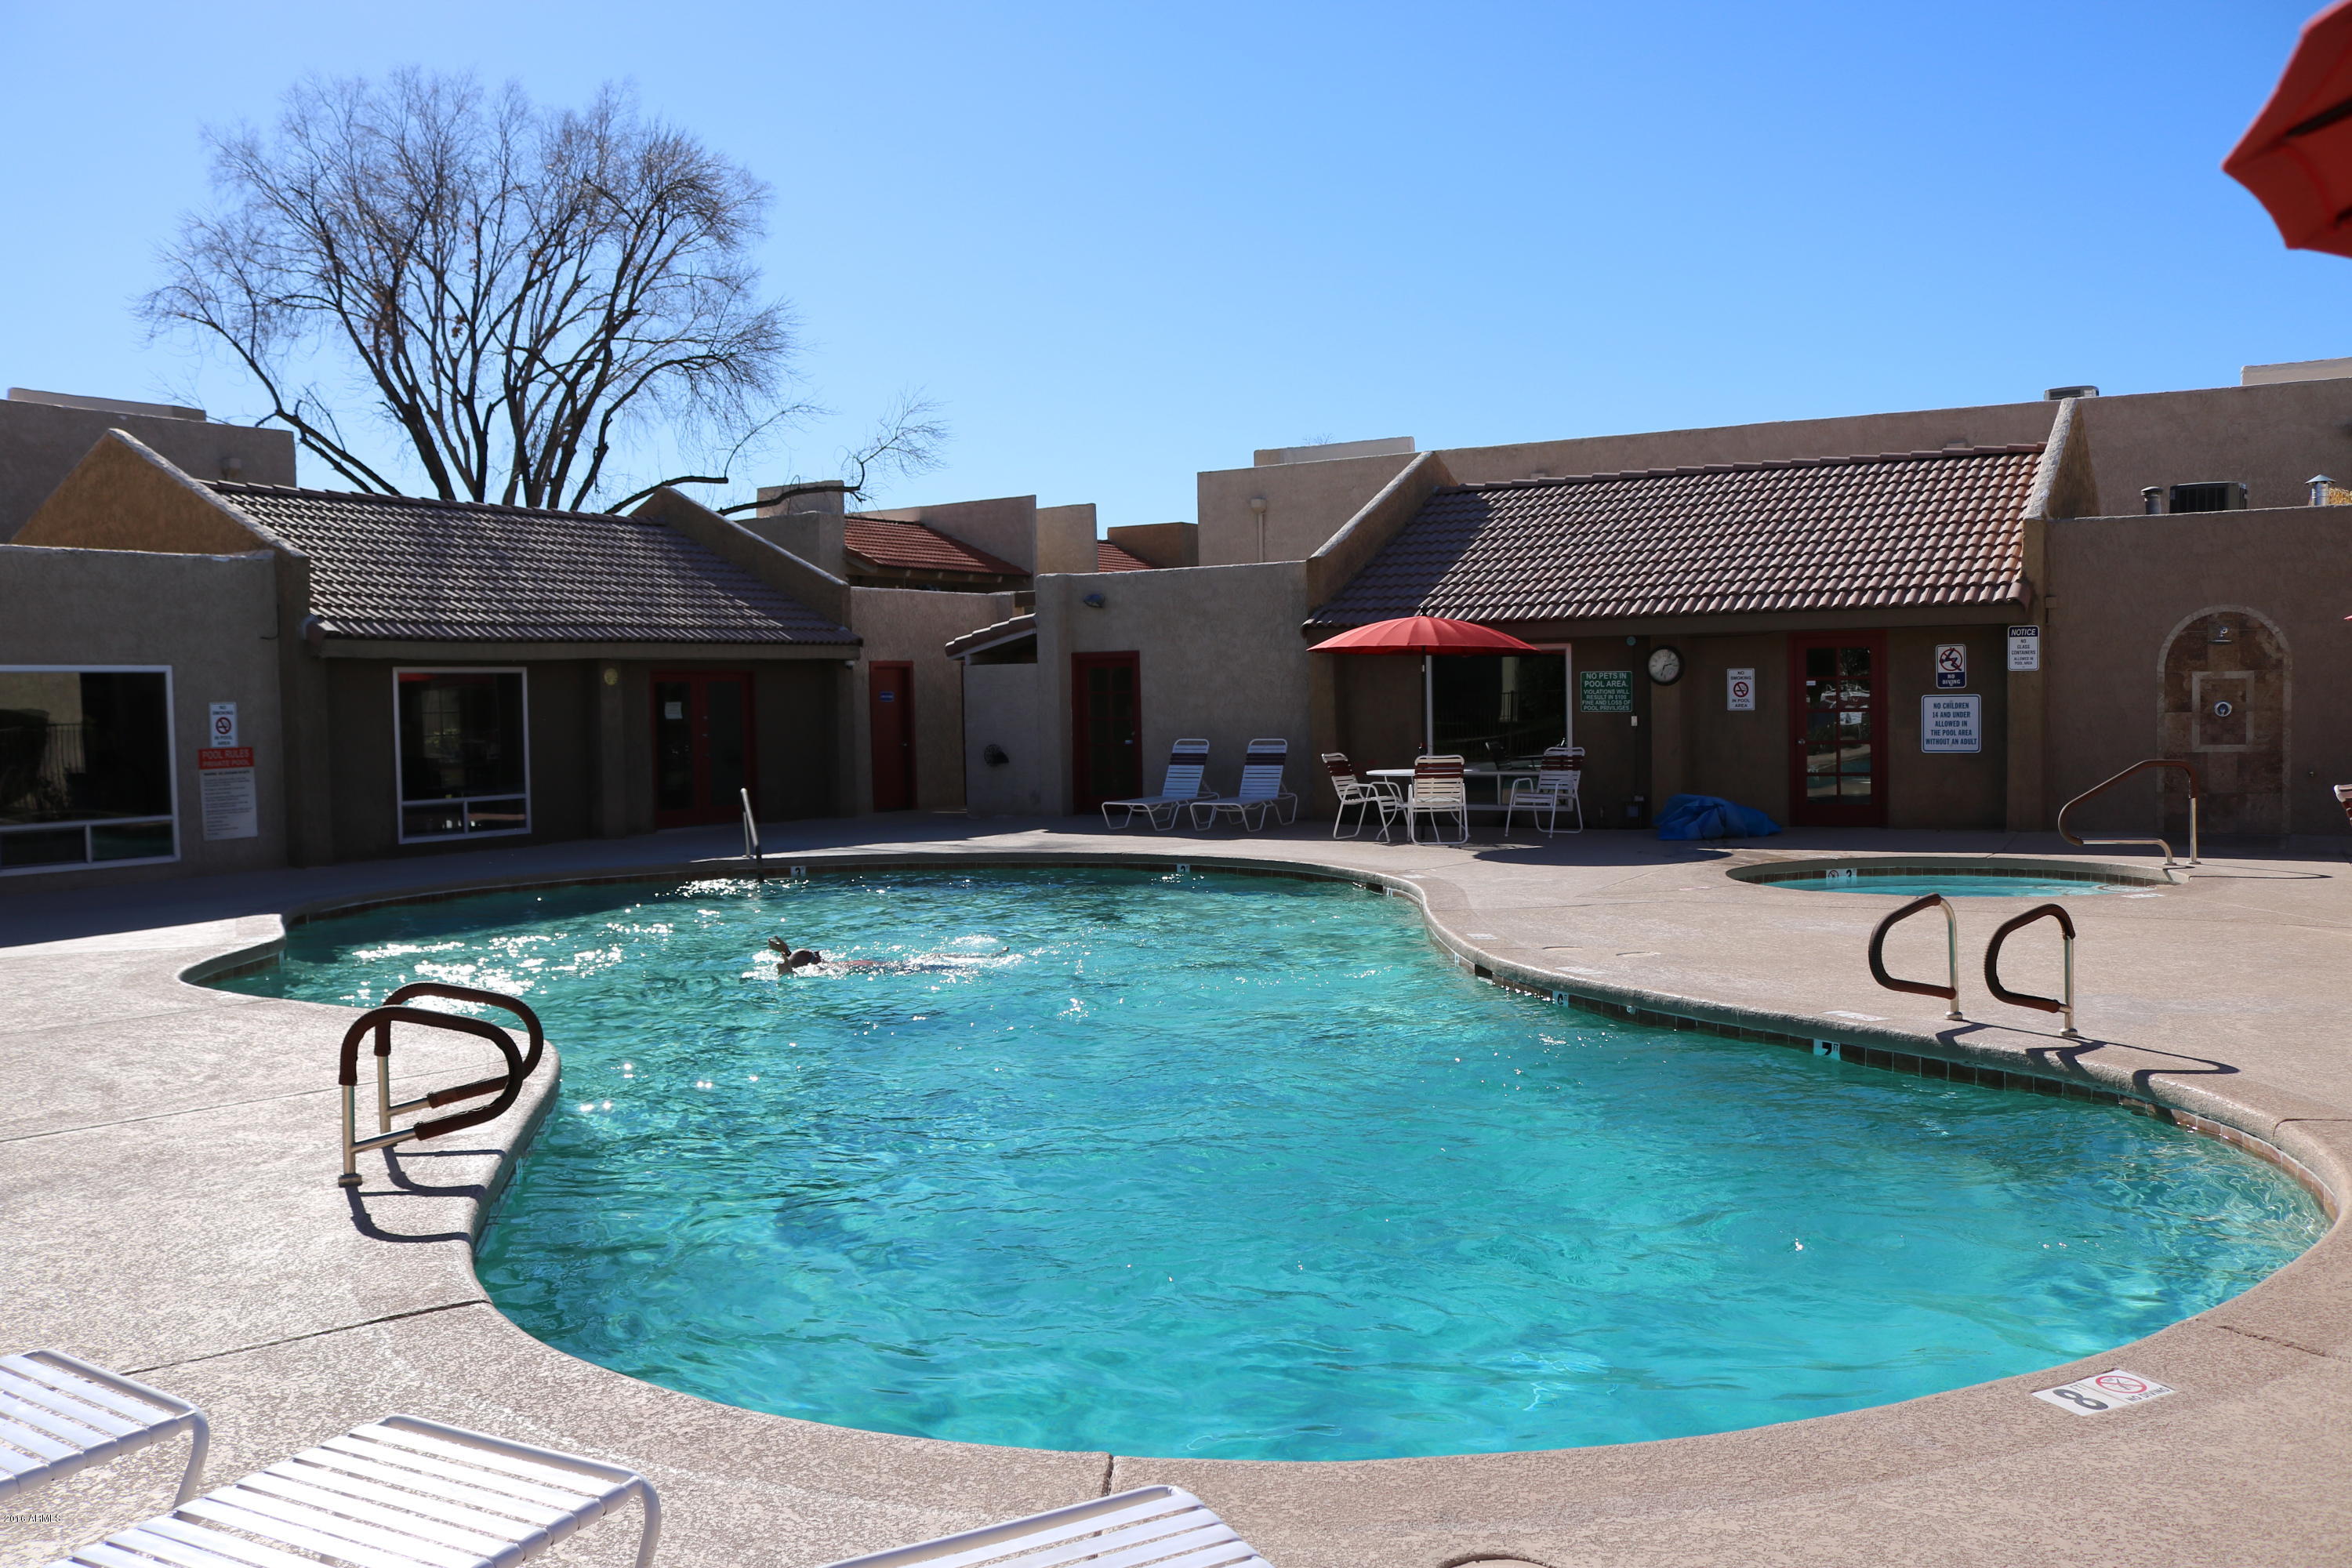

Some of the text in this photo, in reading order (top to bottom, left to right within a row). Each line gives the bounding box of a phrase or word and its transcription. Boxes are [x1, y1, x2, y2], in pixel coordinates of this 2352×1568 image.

[201, 749, 250, 760] POOL RULES
[2139, 1388, 2169, 1398] DIVING
[2053, 1388, 2109, 1410] 8
